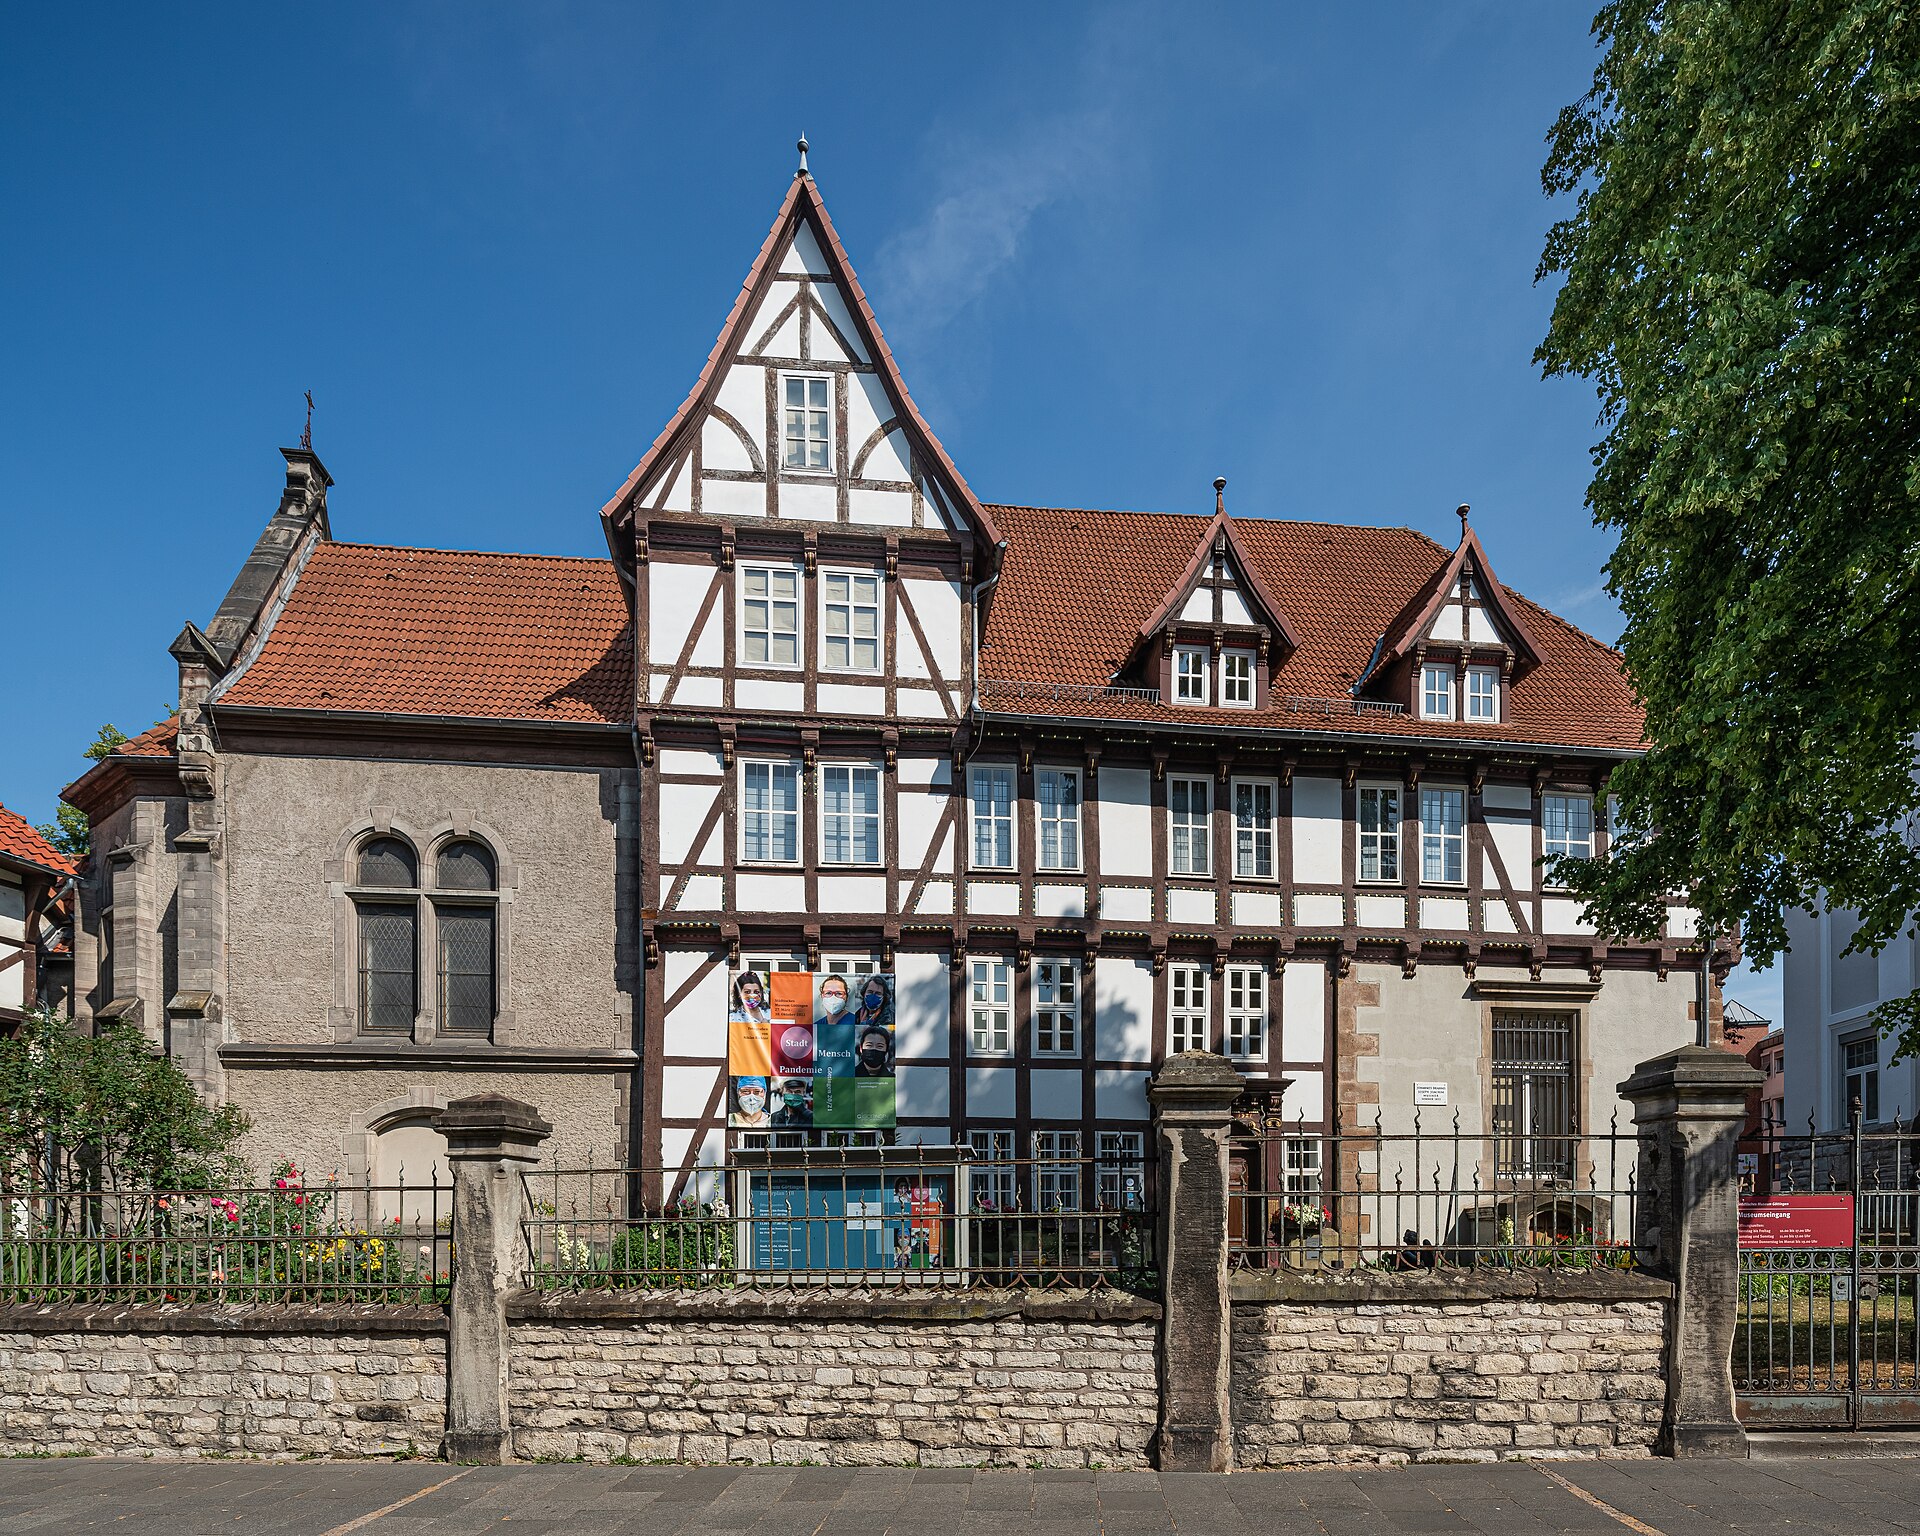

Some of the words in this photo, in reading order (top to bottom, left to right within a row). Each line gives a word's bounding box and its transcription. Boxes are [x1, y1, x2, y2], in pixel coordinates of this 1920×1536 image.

[785, 1039, 809, 1047] Stadt
[818, 1049, 851, 1057] Mensch
[779, 1065, 823, 1074] Pandemie
[1738, 1211, 1791, 1219] Museumseingang
